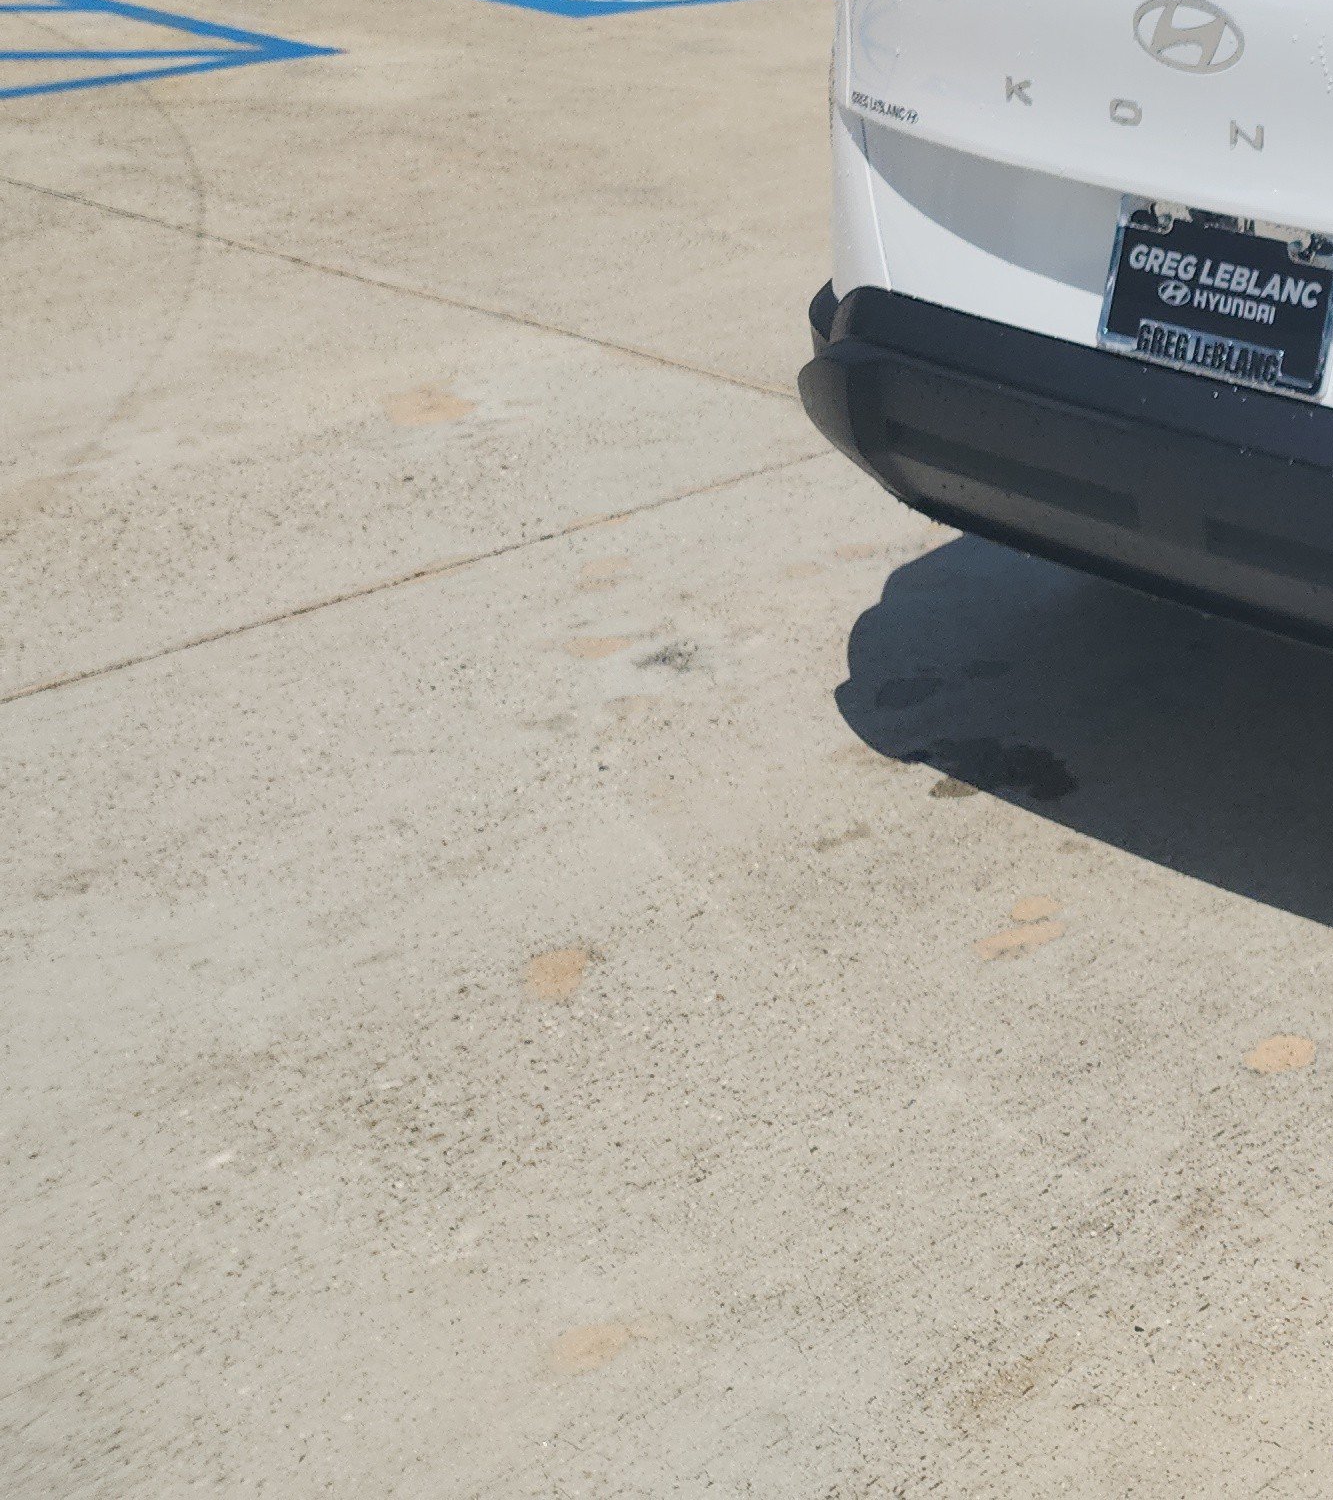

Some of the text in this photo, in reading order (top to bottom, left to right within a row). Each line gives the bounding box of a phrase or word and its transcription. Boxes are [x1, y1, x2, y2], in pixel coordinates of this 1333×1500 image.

[1129, 243, 1323, 309] GREG LEBLANC
[1192, 288, 1276, 325] HYUNDAI
[1137, 323, 1191, 361] GREG
